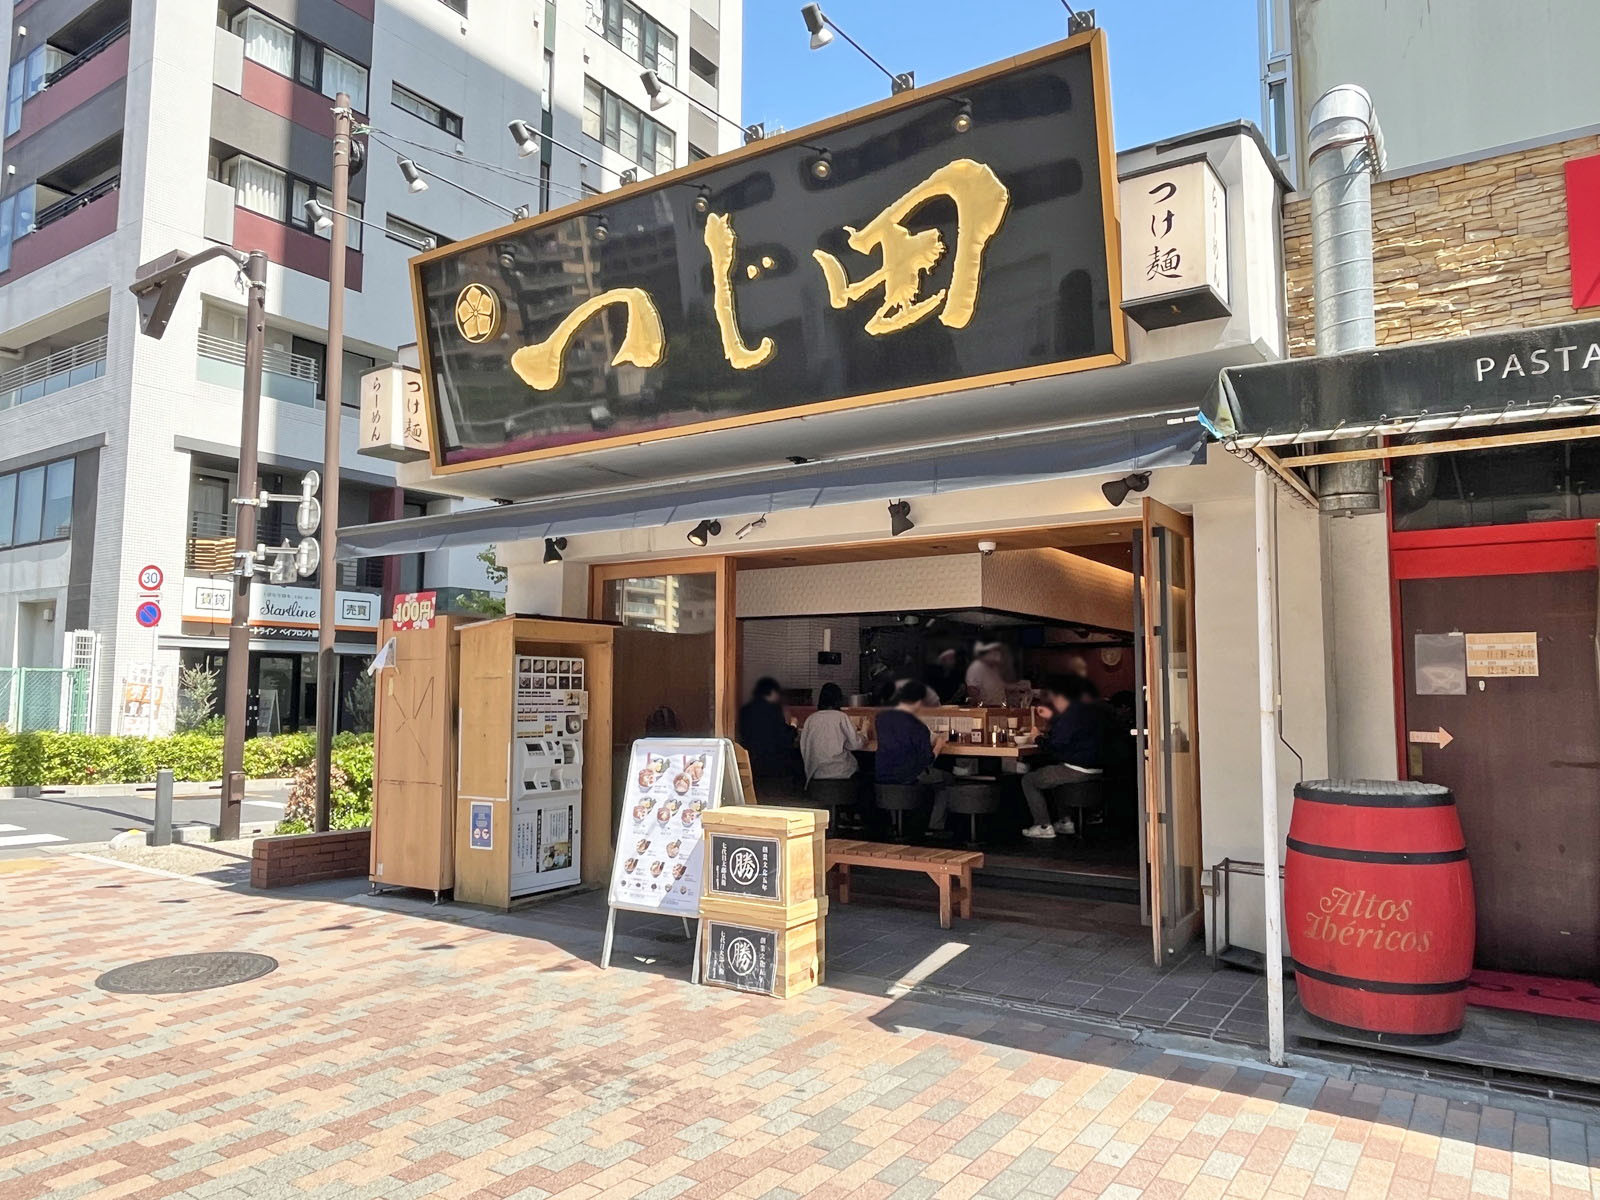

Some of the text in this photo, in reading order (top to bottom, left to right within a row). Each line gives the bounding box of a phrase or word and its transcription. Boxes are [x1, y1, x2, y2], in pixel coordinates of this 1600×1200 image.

[1146, 182, 1183, 281] つけ麺
[510, 157, 1010, 392] つじ田
[1476, 343, 1600, 382] PASTA
[371, 376, 381, 442] らーめん
[404, 381, 423, 443] つけ麺
[143, 572, 158, 584] 30
[260, 599, 317, 619] Startline
[346, 604, 367, 617] 売買
[396, 600, 432, 623] 100円
[733, 852, 756, 880] 勝
[1320, 887, 1412, 922] Altos
[1304, 912, 1433, 953] Ibéricos
[731, 942, 753, 971] 勝
